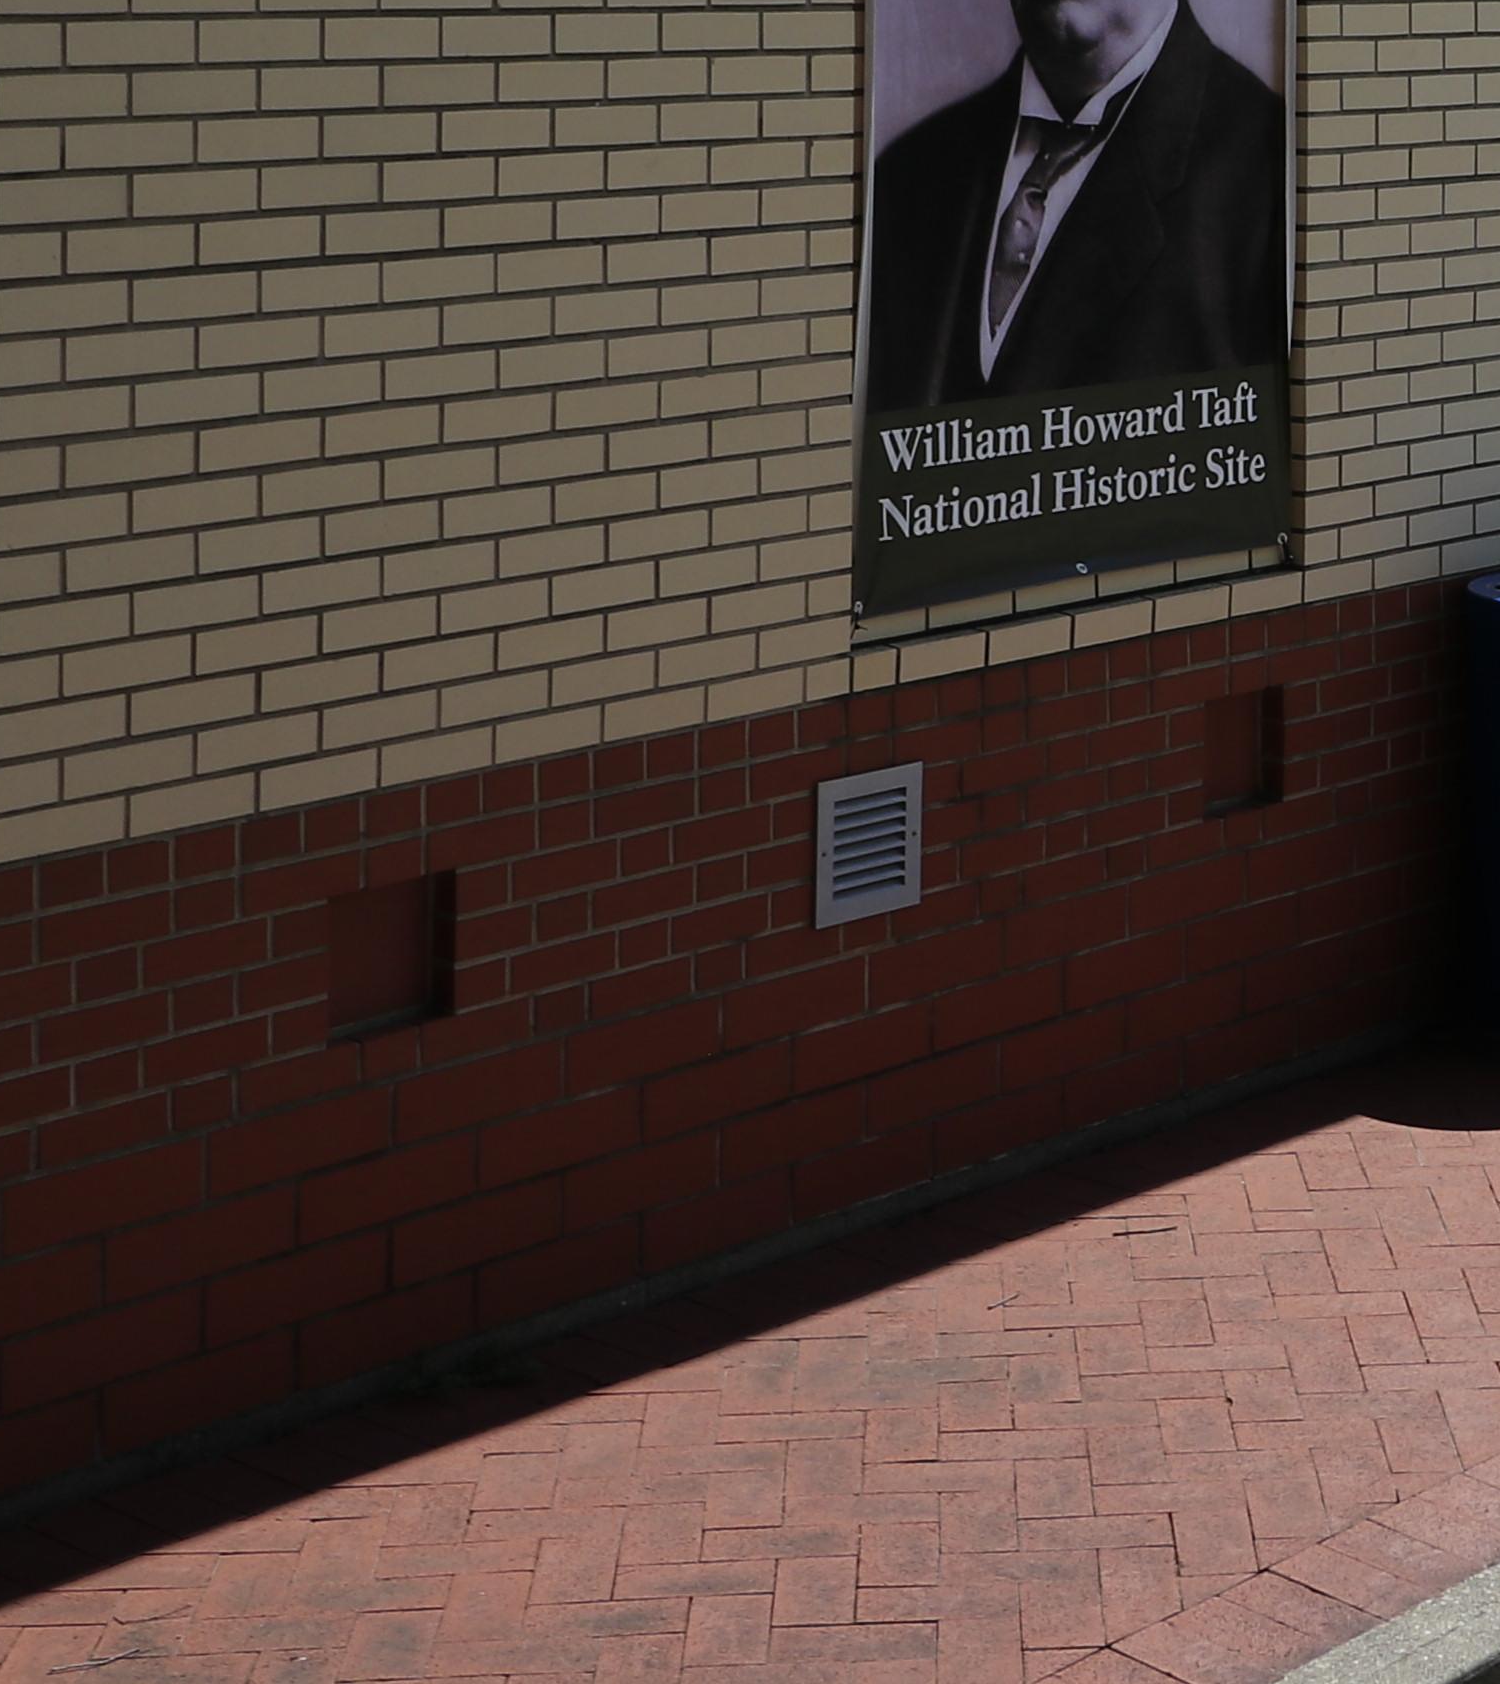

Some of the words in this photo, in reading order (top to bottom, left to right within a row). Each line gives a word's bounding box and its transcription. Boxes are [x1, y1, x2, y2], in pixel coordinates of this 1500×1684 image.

[880, 416, 1032, 473] William
[1040, 390, 1185, 451] Howard
[1192, 380, 1257, 430] Taft
[878, 473, 1043, 542] National
[1052, 453, 1197, 513] Historic
[1205, 444, 1266, 490] Site
